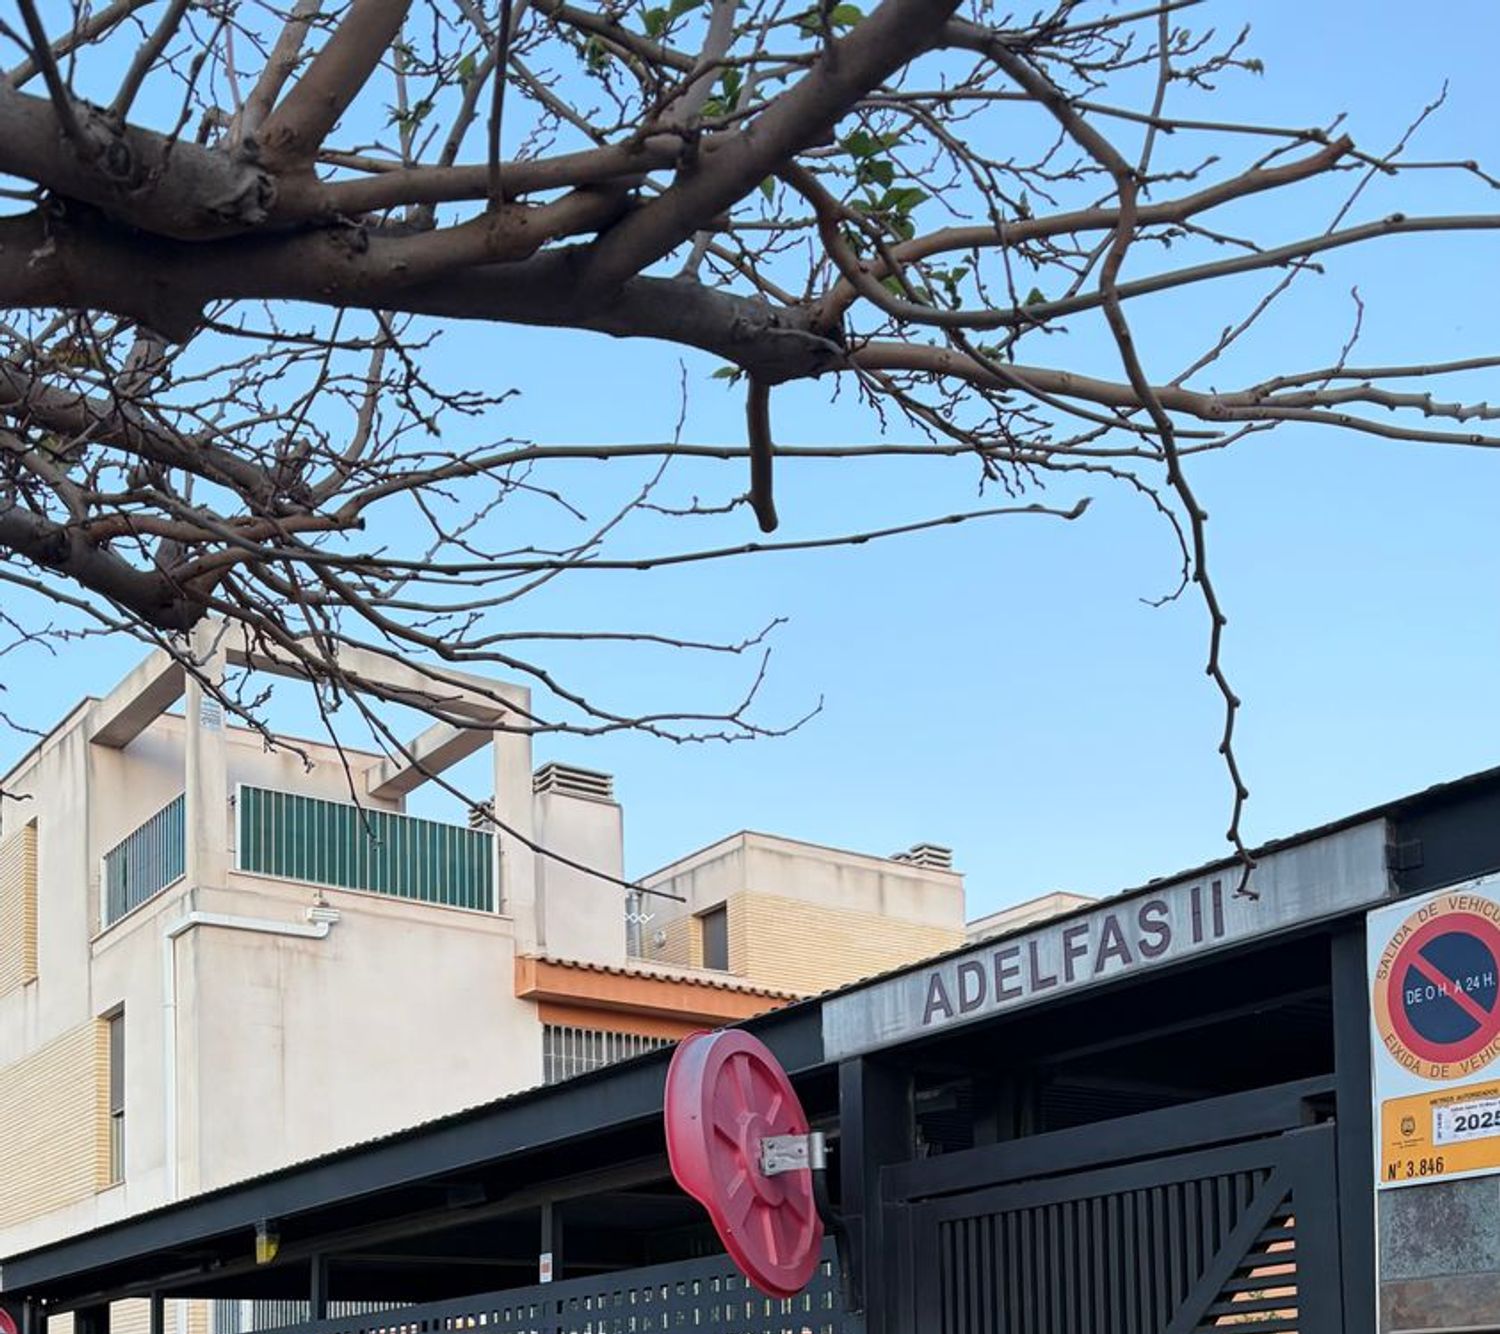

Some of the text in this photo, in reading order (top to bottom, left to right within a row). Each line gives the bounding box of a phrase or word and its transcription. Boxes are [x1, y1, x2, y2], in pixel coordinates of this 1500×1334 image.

[923, 880, 1225, 1025] ADELFAS II
[1377, 924, 1413, 980] SALIDA
[1417, 902, 1439, 923] DE
[1406, 988, 1422, 1005] DE
[1454, 979, 1464, 994] A
[1466, 975, 1480, 991] 24
[1384, 1033, 1420, 1073] EIXIDA
[1430, 1065, 1449, 1078] DE
[1407, 1156, 1444, 1178] 3.846
